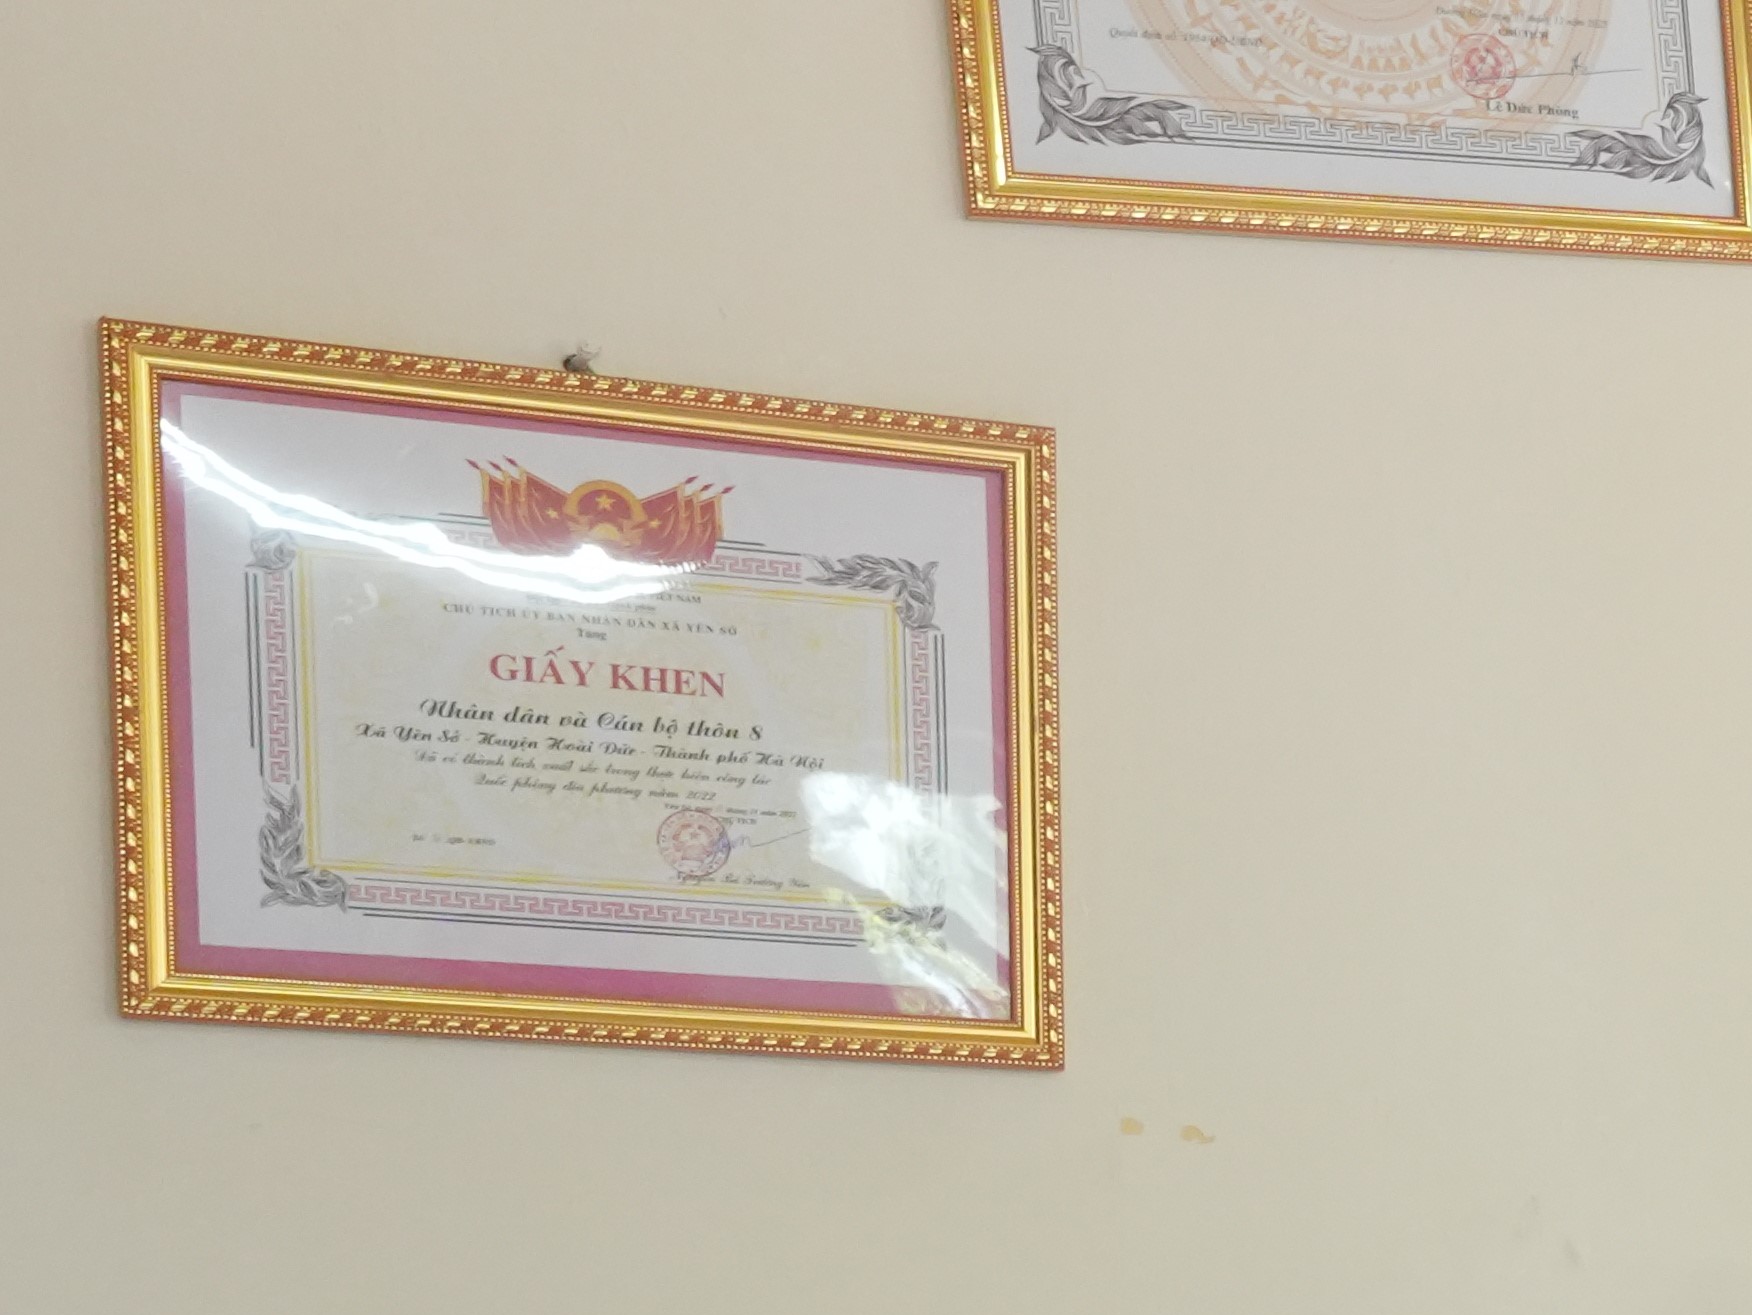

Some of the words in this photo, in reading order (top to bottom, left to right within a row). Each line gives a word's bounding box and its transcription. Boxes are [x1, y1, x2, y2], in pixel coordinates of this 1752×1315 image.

[489, 644, 595, 688] GIẤY
[609, 663, 726, 698] KHEN
[419, 698, 494, 721] Nhân
[503, 706, 549, 725] dân
[559, 709, 588, 728] và
[596, 711, 643, 733] Cán
[652, 716, 678, 739] bộ
[687, 719, 740, 740] thôn
[749, 724, 765, 741] 8
[355, 723, 385, 738] Xã
[393, 725, 432, 743] Yên
[478, 731, 539, 751] Huyện
[546, 737, 593, 754] Hoài
[653, 744, 710, 762] Thành
[716, 750, 751, 766] phố
[755, 751, 784, 768] Hà
[789, 754, 825, 771] Nội
